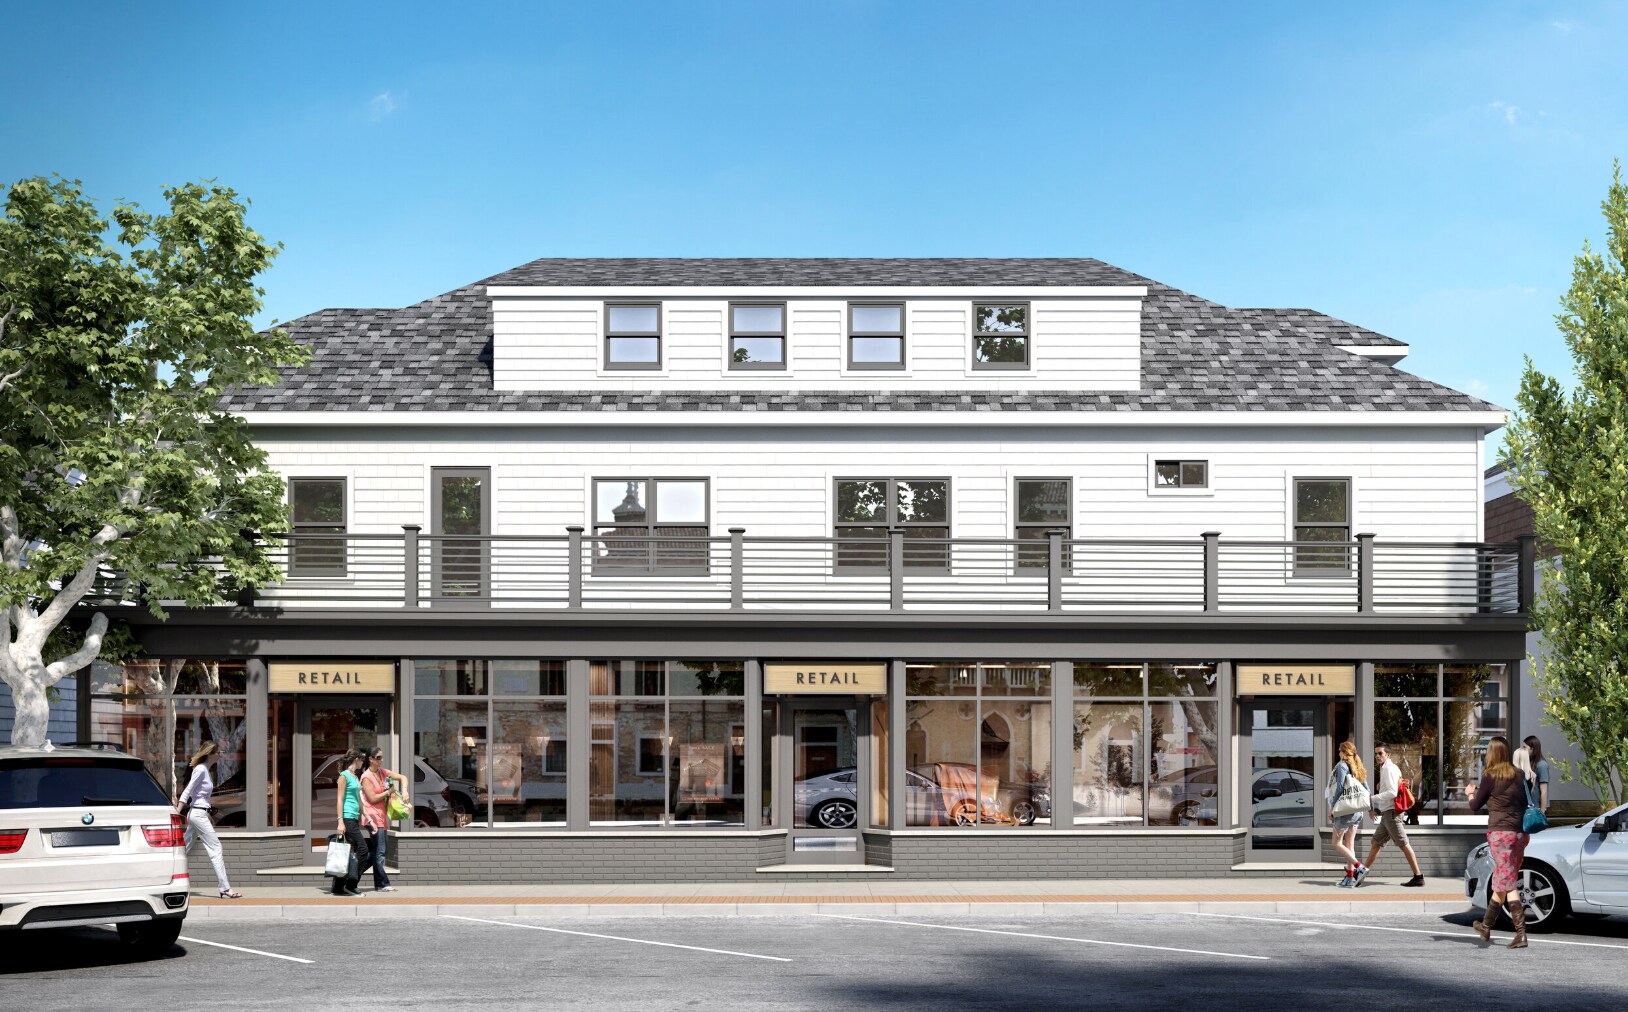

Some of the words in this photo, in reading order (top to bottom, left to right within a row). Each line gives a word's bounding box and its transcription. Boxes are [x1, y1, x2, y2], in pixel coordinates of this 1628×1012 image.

[298, 671, 361, 684] RETAIL
[796, 672, 859, 684] RETAIL
[1262, 673, 1325, 685] RETAIL
